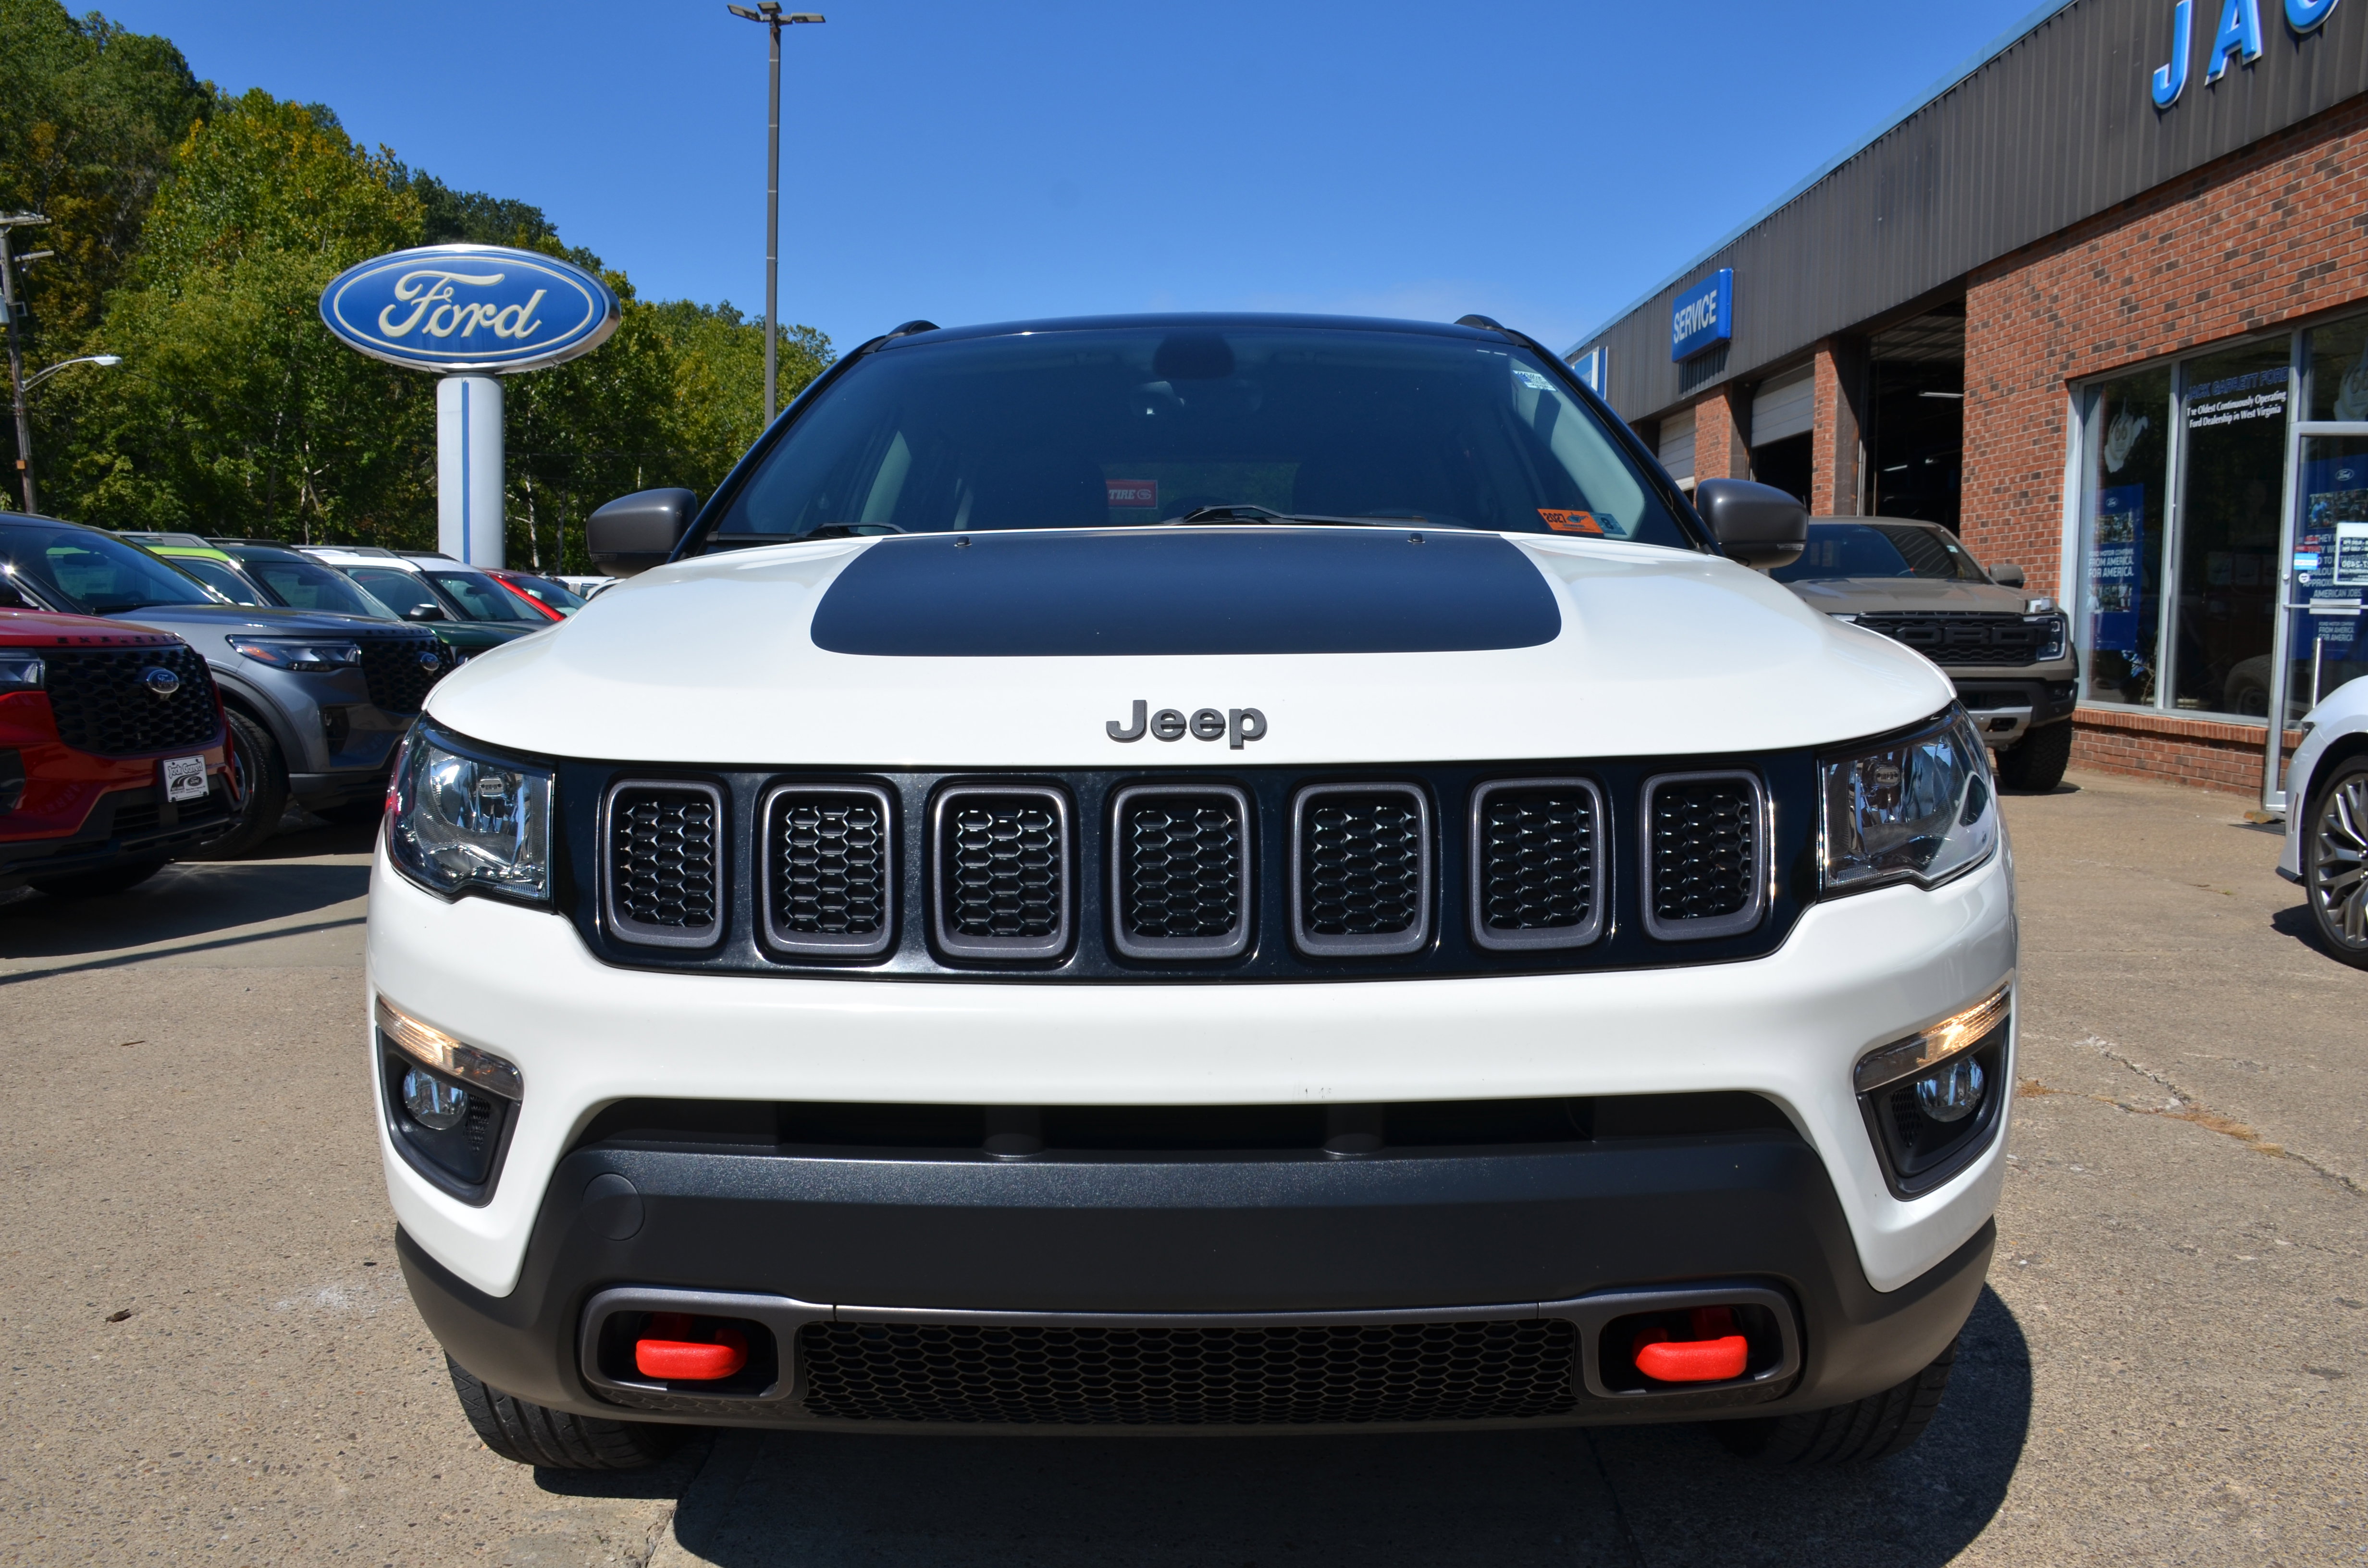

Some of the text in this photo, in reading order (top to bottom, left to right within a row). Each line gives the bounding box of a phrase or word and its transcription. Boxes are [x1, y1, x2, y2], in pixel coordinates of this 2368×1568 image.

[378, 270, 547, 339] Ford
[1673, 290, 1717, 343] SERVICE
[2186, 366, 2290, 401] JACK GARRETT FORD
[2197, 403, 2216, 415] Oldest
[2216, 395, 2254, 412] Continuously
[2255, 390, 2287, 405] Operating
[2189, 404, 2282, 428] Ford Dealership in West Virginia
[1109, 490, 1135, 500] TIRE
[1543, 513, 1566, 523] 2027
[1601, 517, 1614, 530] 8
[2088, 556, 2134, 567] FROM AMERICA.
[2088, 566, 2134, 578] FOR AMERICA.
[2313, 589, 2347, 598] AMERICAN
[1106, 699, 1268, 750] Jeep
[168, 761, 203, 779] Jack Garrett
